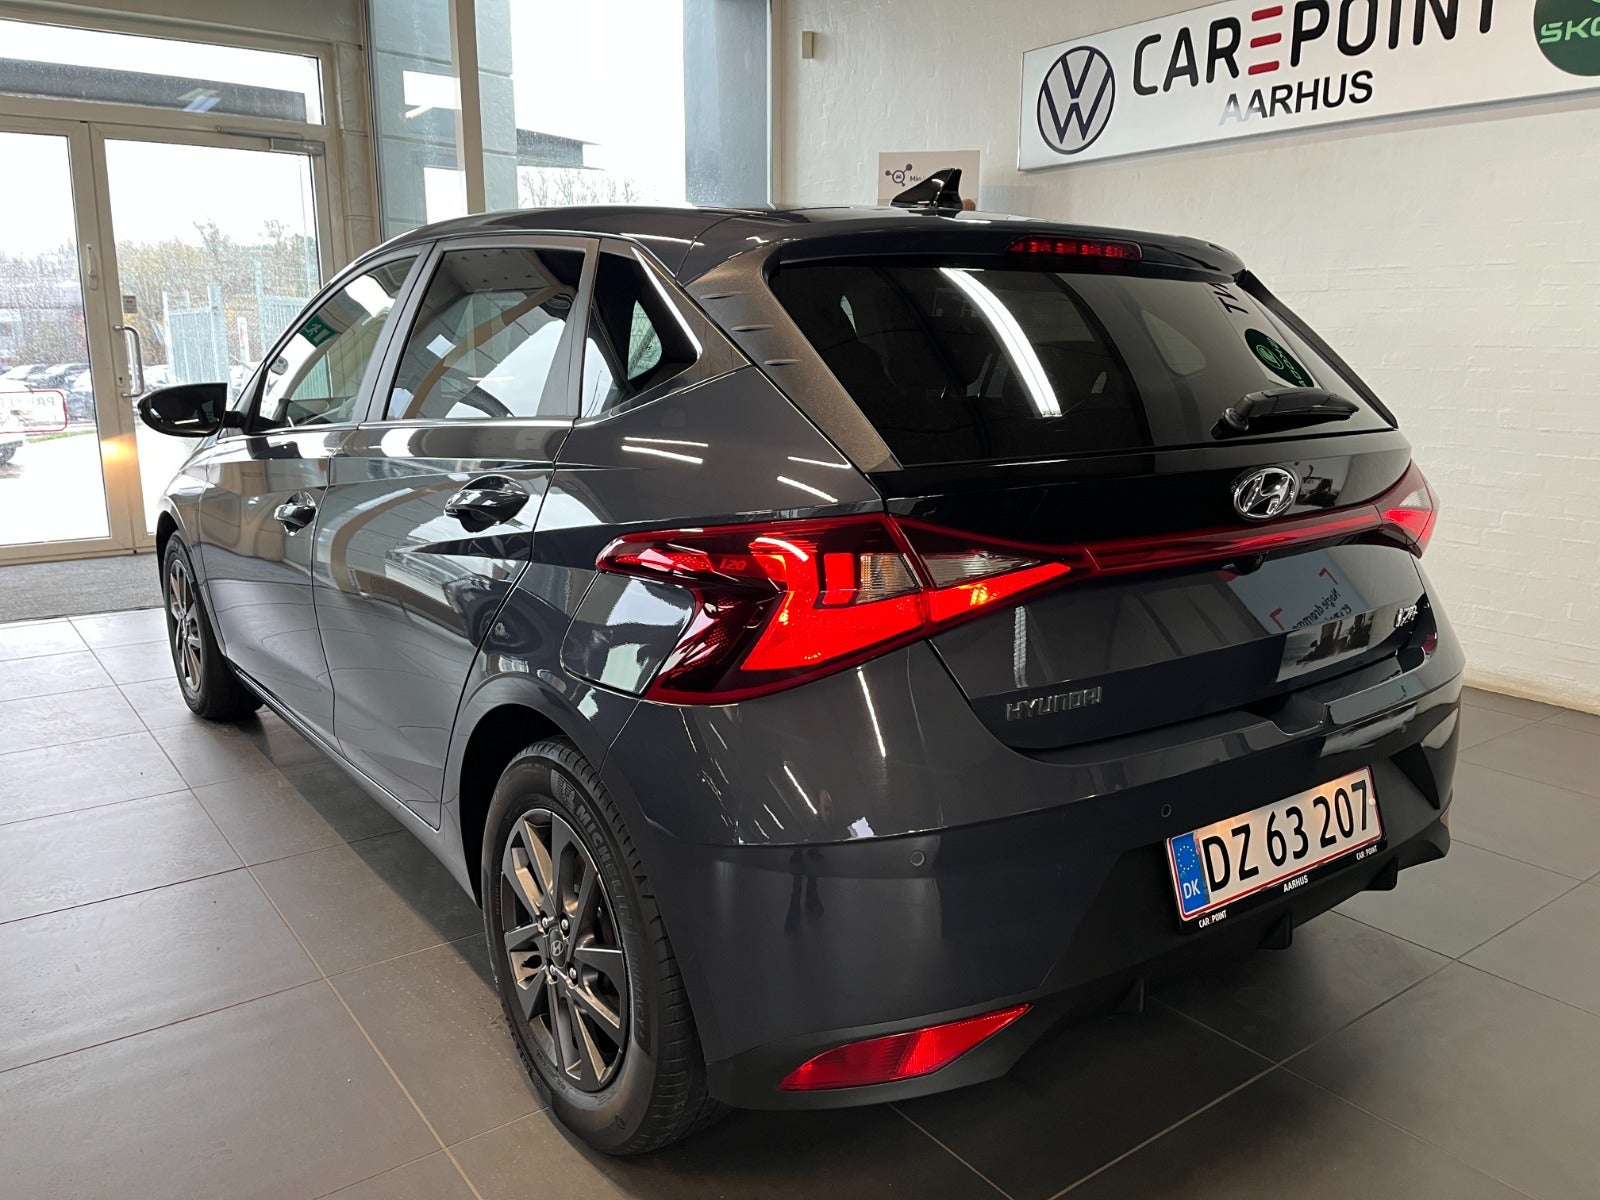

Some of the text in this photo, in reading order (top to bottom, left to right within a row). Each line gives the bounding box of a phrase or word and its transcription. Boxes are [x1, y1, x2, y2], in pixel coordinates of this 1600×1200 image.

[1219, 69, 1374, 126] AARHUS
[1006, 686, 1103, 722] HYUNDAI
[1201, 779, 1367, 893] DZ 63 207
[1183, 878, 1201, 900] DK
[1283, 875, 1309, 893] AARHUS
